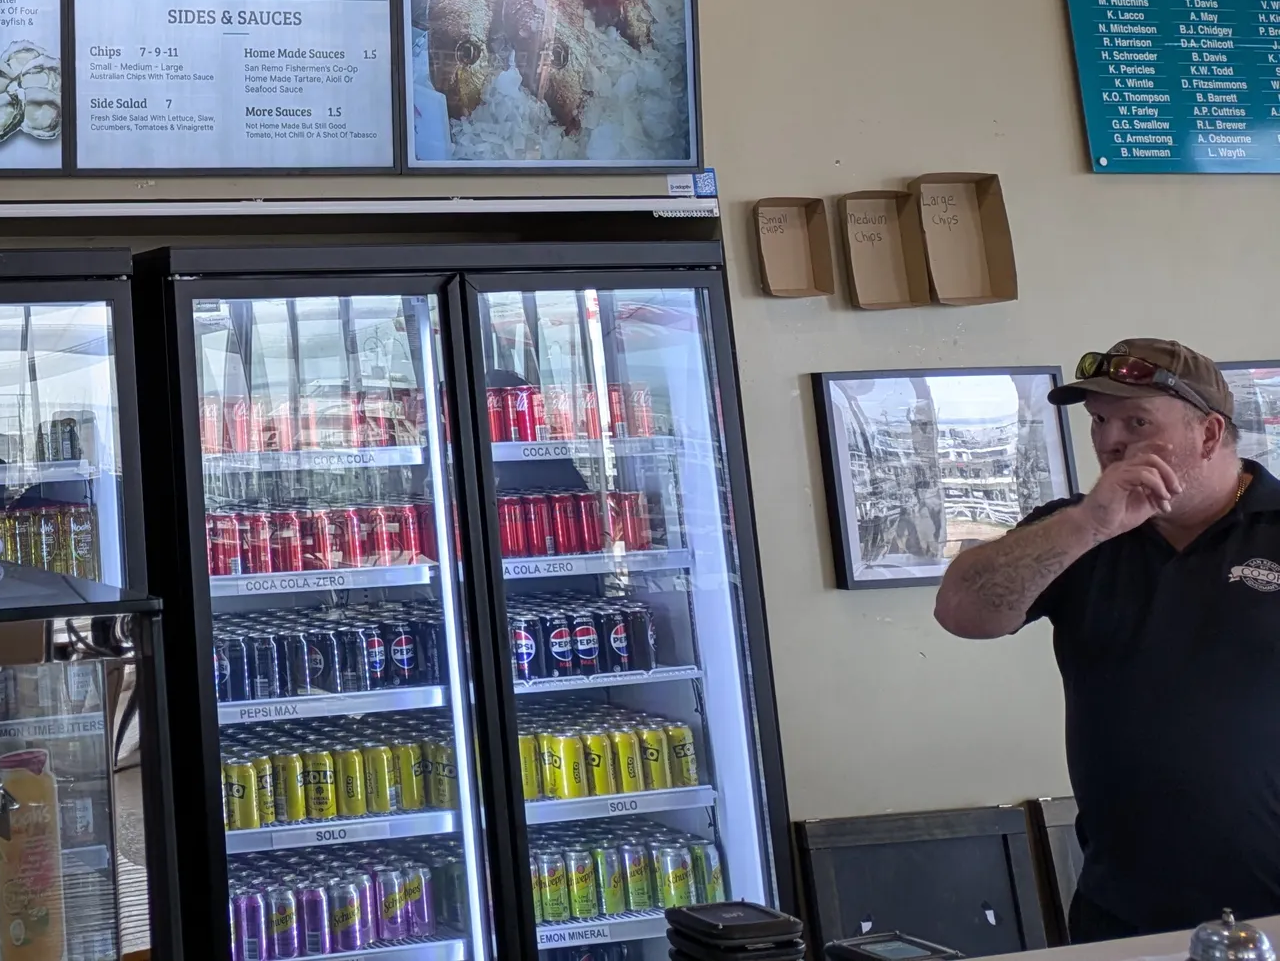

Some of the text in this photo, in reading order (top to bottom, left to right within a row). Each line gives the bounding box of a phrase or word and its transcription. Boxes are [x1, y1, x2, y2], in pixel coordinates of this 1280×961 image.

[1194, 0, 1218, 8] Davis
[168, 9, 302, 26] SIDES & SAUCES
[1099, 24, 1157, 35] N. Mitchelson
[1109, 65, 1155, 74] K. Pericles
[1196, 93, 1237, 102] B. Barrett
[90, 98, 172, 109] Side Salad 7
[246, 107, 341, 117] More Sauces 1.5
[1121, 148, 1171, 157] B. Newman
[522, 447, 551, 457] COCA
[313, 454, 375, 466] COCA COLA
[513, 563, 573, 575] COLA -ZERO
[245, 576, 345, 591] COCA COLA -ZERO
[240, 704, 299, 719] PEPSI MAX
[609, 800, 637, 812] SOLO
[316, 828, 347, 841] SOLO
[568, 929, 608, 941] MINERAL
